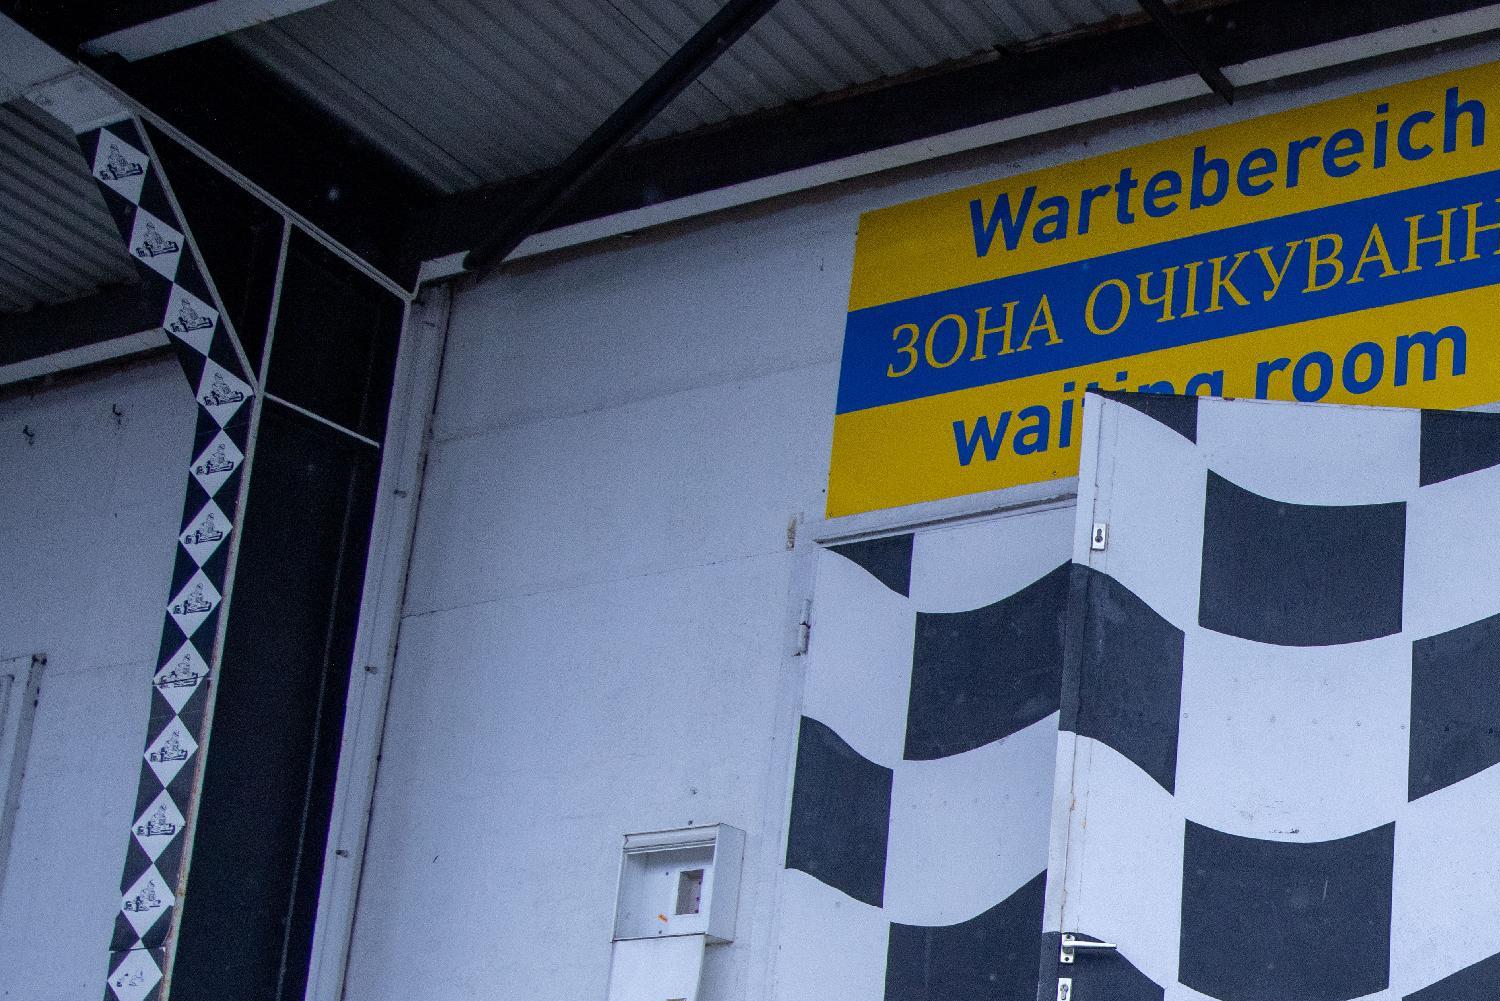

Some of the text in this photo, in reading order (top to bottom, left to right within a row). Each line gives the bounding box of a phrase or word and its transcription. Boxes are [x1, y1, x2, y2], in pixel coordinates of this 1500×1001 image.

[969, 86, 1487, 258] Wartebereich
[886, 293, 1064, 378] ЗОНА
[1255, 325, 1467, 403] room
